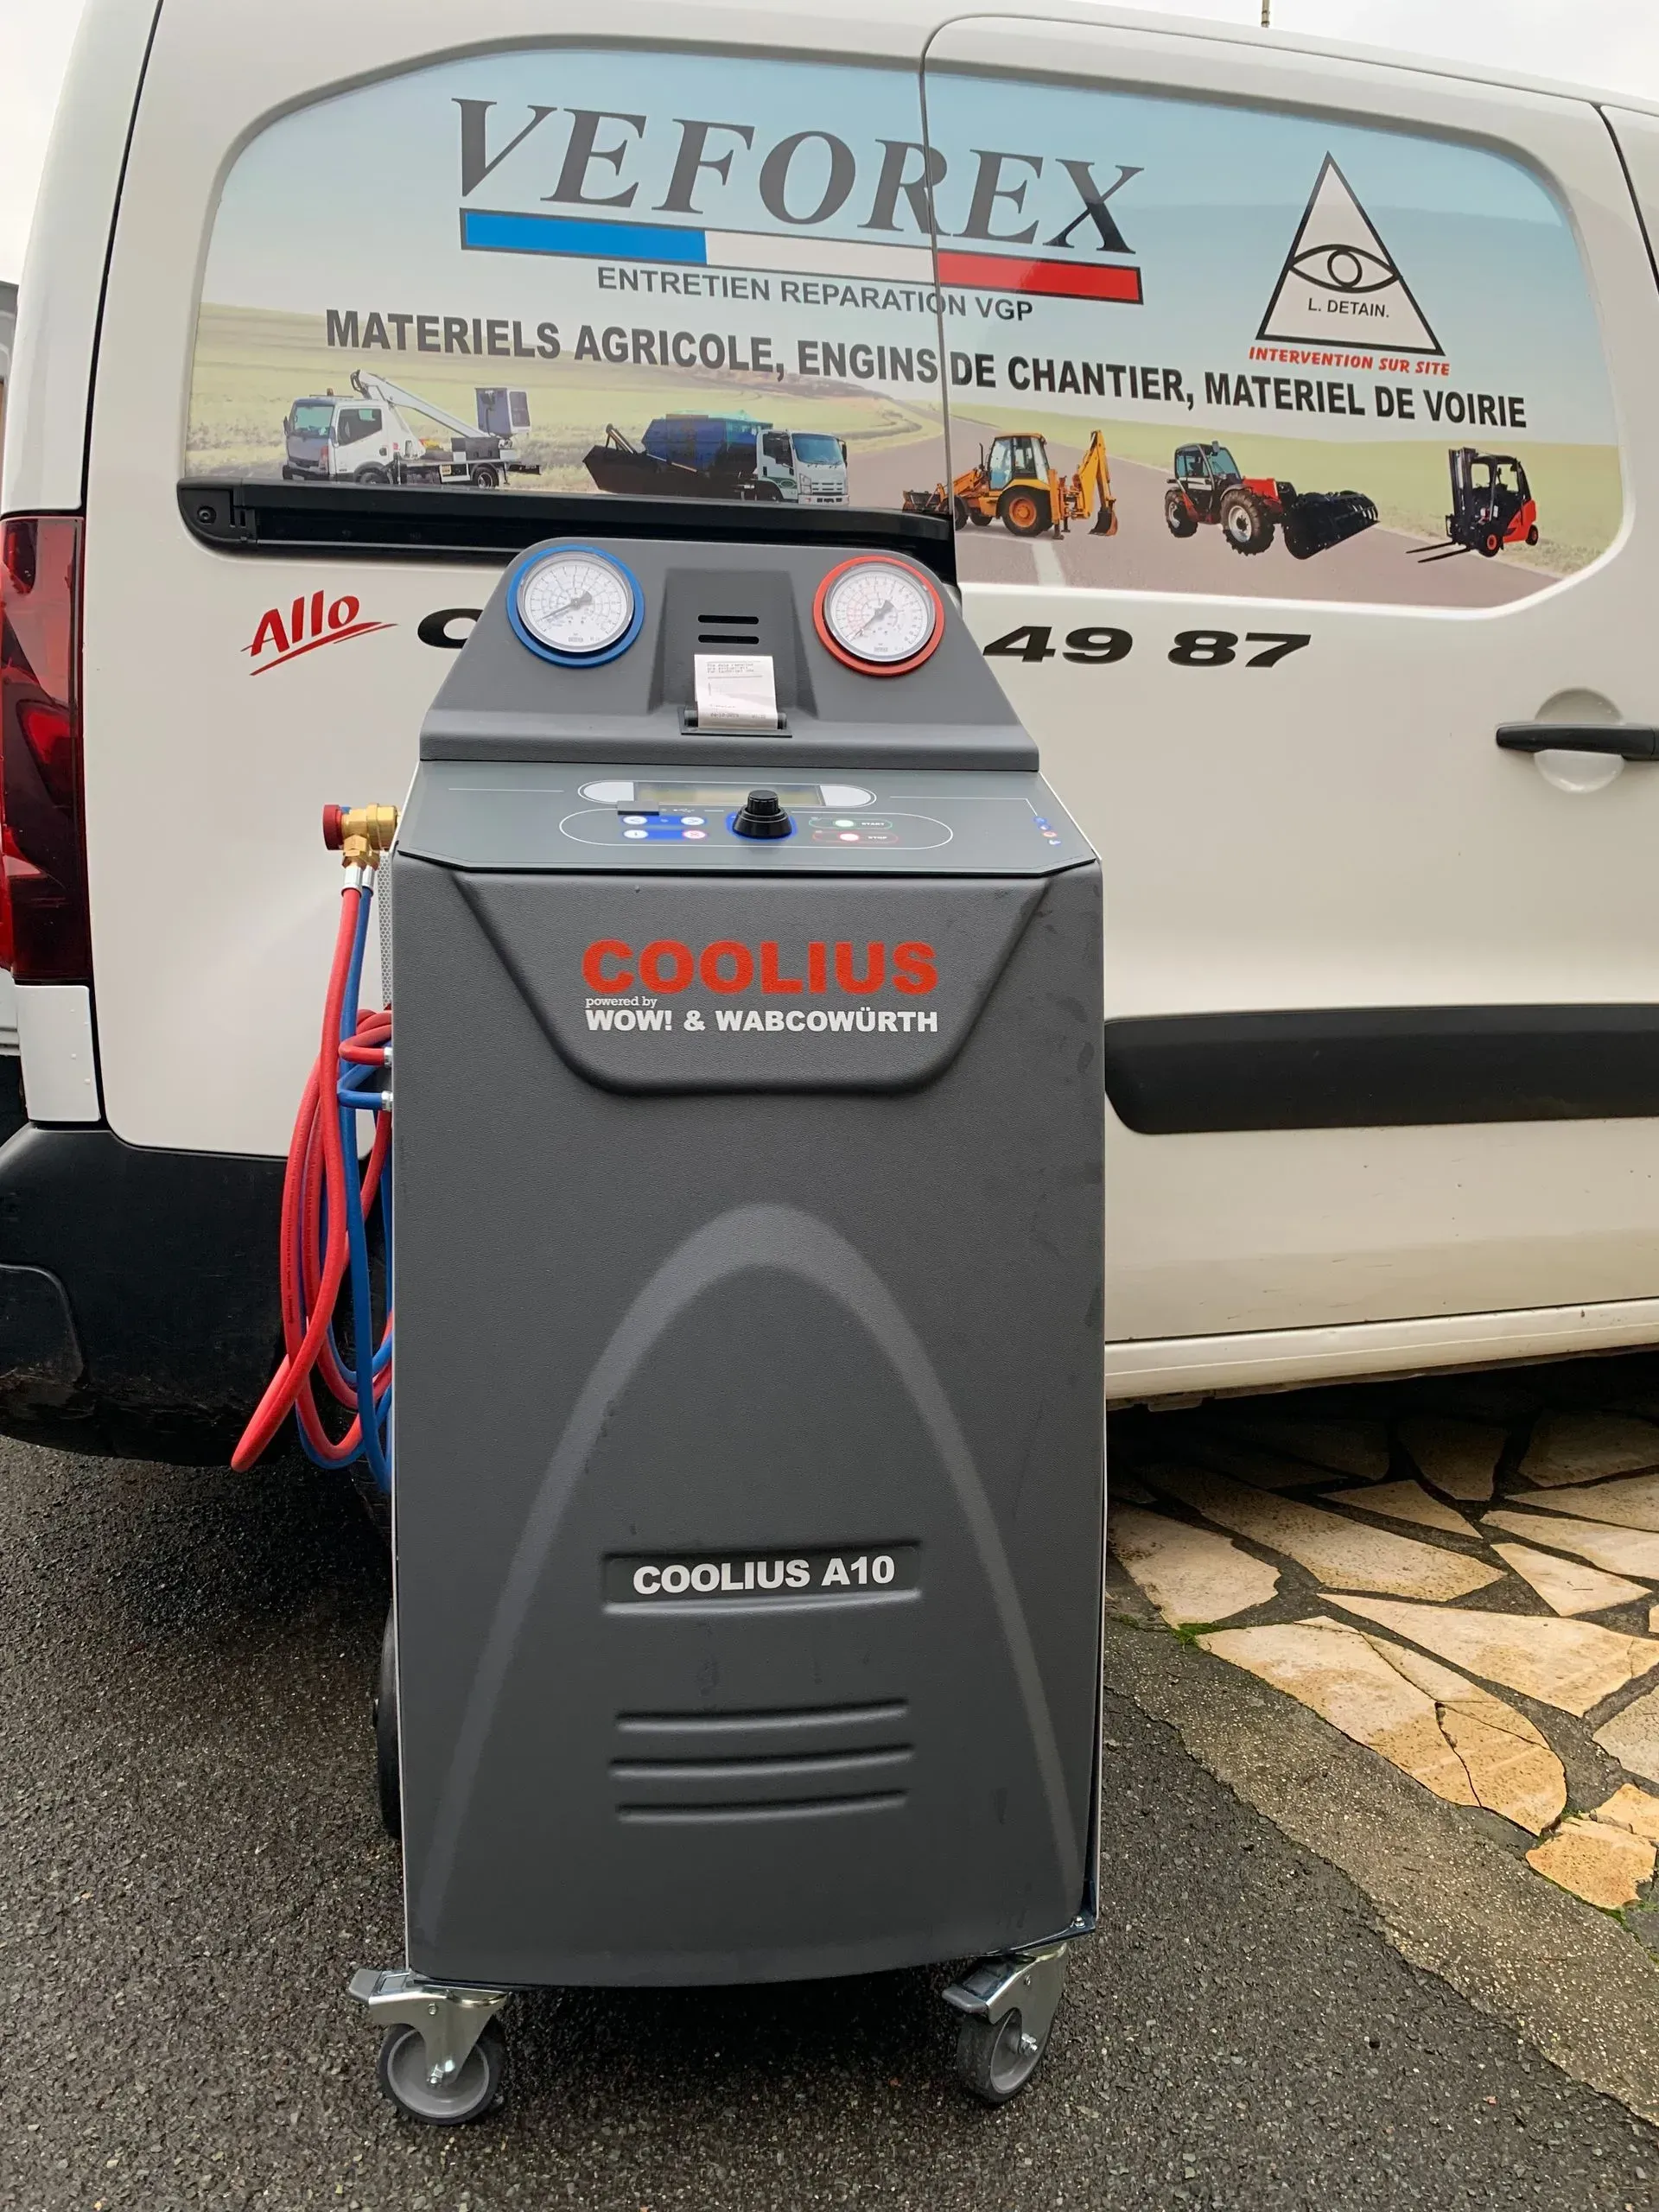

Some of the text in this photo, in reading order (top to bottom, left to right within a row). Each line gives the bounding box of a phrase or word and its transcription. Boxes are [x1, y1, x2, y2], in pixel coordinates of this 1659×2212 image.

[452, 98, 1145, 254] VEFOREX
[597, 266, 1033, 321] ENTRETIEN REPARATION VGP
[1308, 298, 1389, 318] L. DETAIN.
[326, 308, 1528, 429] MATERIELS AGRICOLE, ENGINS DE CHANTIER, MATERIEL DE VOIRIE
[1249, 346, 1451, 377] INTERVENTION SUR SITE
[242, 589, 360, 658] Allo
[982, 625, 1133, 665] 49
[1167, 630, 1312, 668] 87
[581, 938, 939, 995] COOLIUS
[585, 996, 658, 1010] powered by
[585, 1007, 938, 1033] WOW! & WABCOWÜRTH
[632, 1555, 895, 1595] COOLIUS A10
